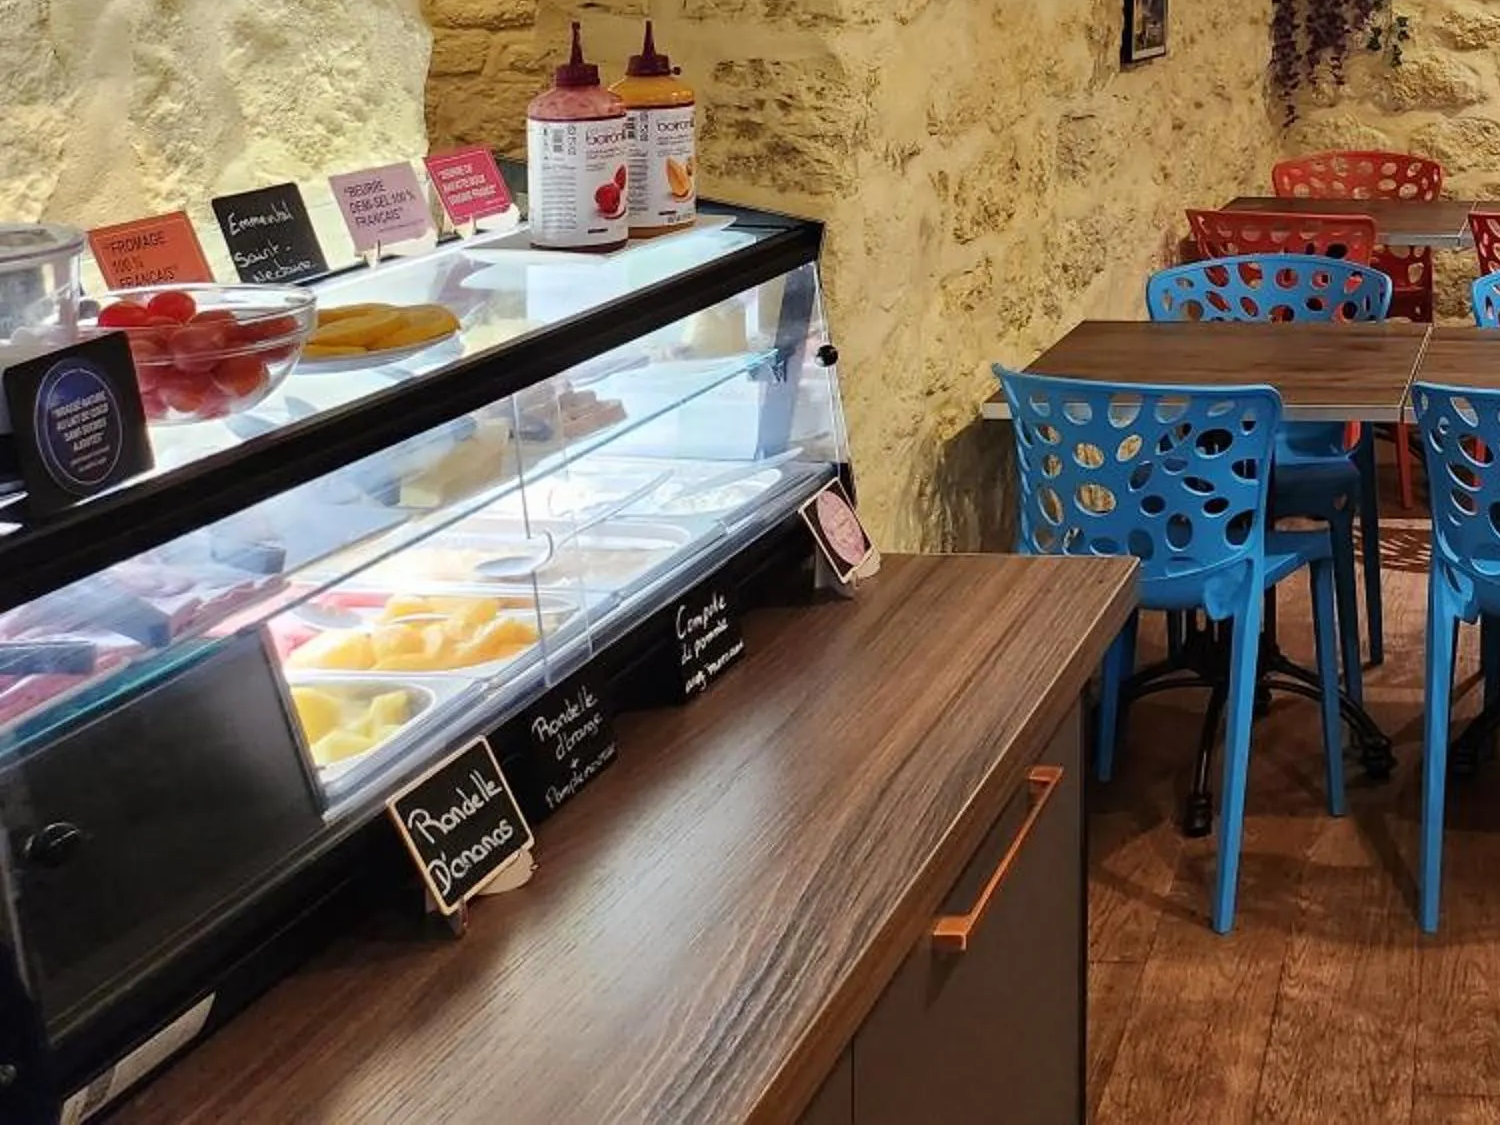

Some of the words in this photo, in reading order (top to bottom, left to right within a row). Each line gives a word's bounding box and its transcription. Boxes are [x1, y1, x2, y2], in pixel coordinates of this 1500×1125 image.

[530, 684, 599, 742] Rondelle
[407, 768, 504, 845] Rondelle
[427, 818, 514, 897] D'ananas
